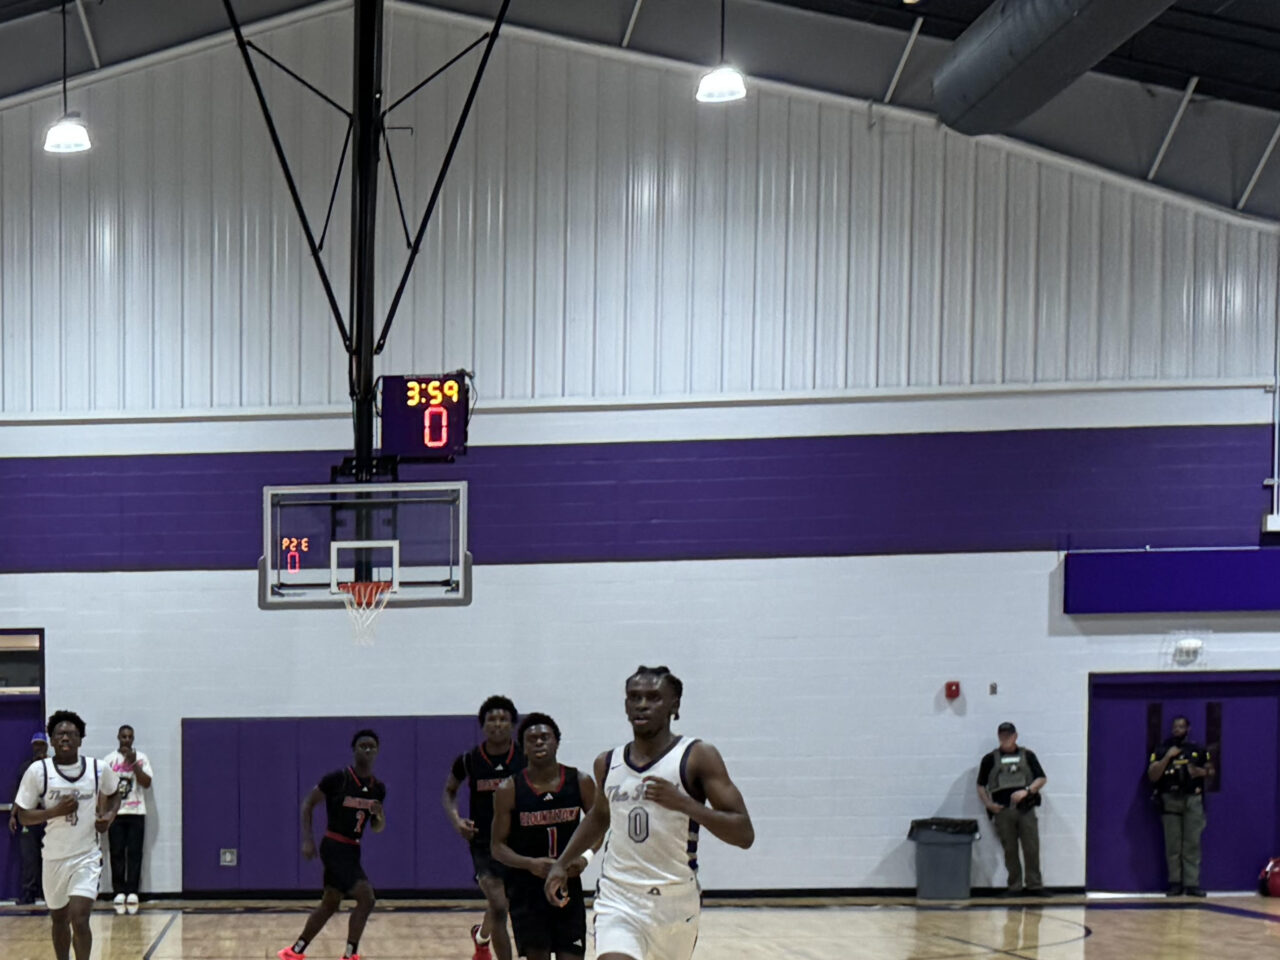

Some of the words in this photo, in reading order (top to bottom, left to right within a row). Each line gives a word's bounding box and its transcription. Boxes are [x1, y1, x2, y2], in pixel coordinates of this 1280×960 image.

[407, 380, 459, 407] 3:59
[424, 406, 448, 448] 0
[628, 806, 649, 843] 0
[547, 826, 558, 858] 1
